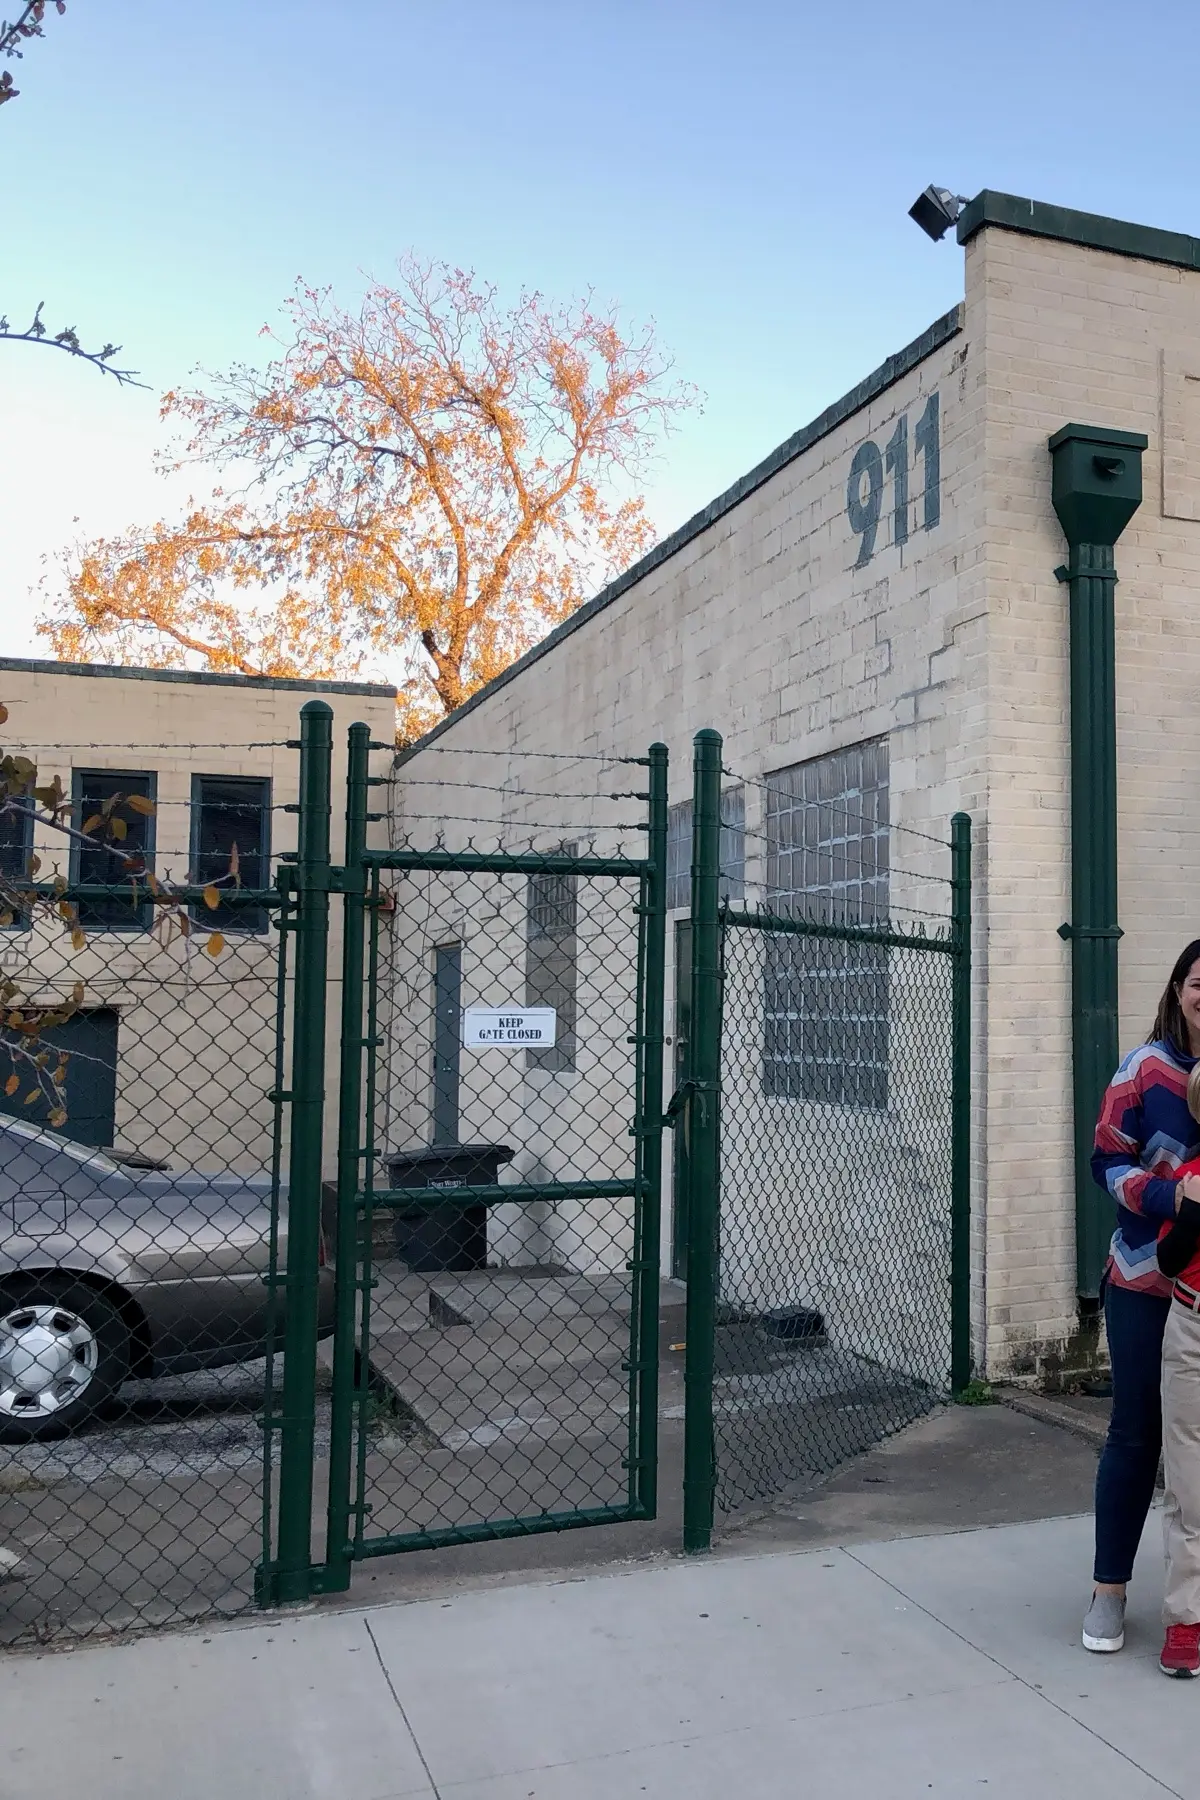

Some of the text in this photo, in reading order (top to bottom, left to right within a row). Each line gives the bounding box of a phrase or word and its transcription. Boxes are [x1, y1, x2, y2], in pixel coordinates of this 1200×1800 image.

[847, 391, 940, 571] 911
[498, 1017, 524, 1029] KEEP
[478, 1029, 542, 1040] GATE CLOSED
